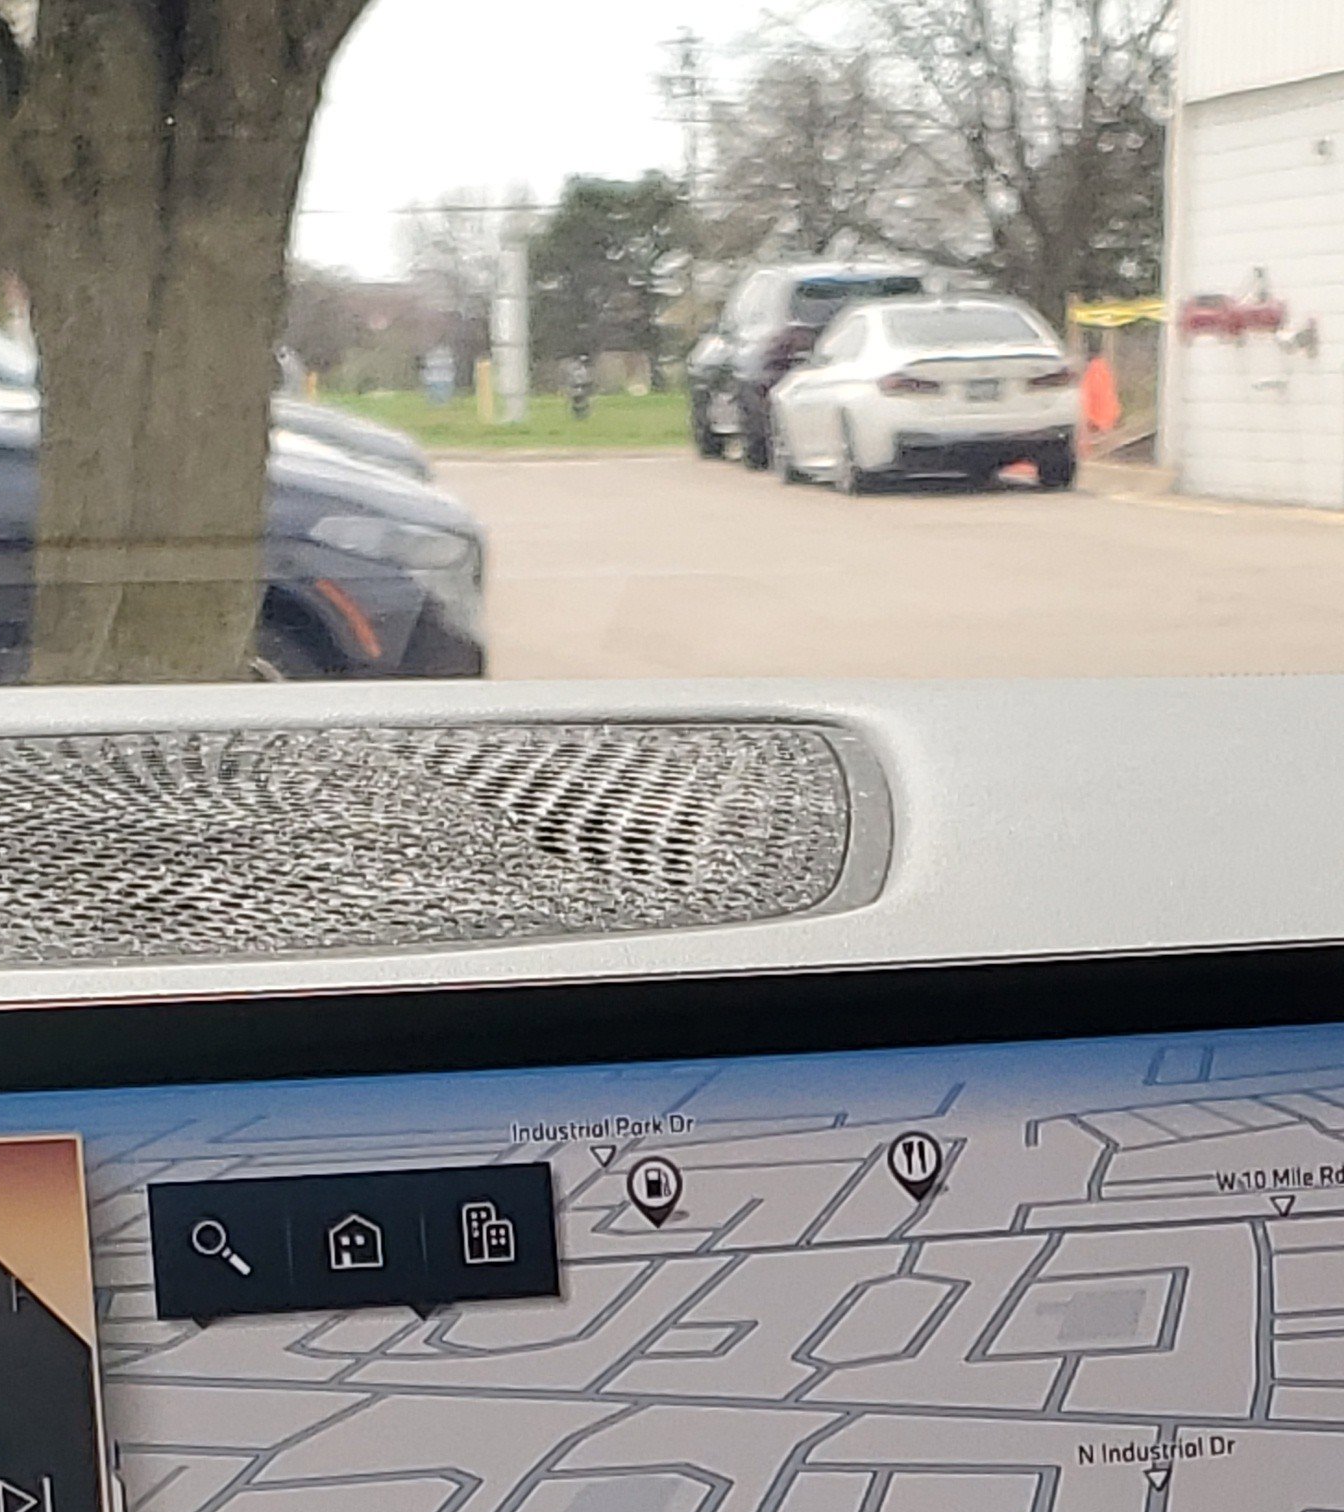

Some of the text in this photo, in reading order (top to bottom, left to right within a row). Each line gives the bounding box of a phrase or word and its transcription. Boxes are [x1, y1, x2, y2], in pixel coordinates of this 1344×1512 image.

[512, 1113, 694, 1143] Industrial Park Dr
[1216, 1169, 1236, 1191] W
[1242, 1169, 1266, 1190] 10
[1272, 1165, 1313, 1188] Mile
[1078, 1435, 1235, 1464] N Industrial Dr
